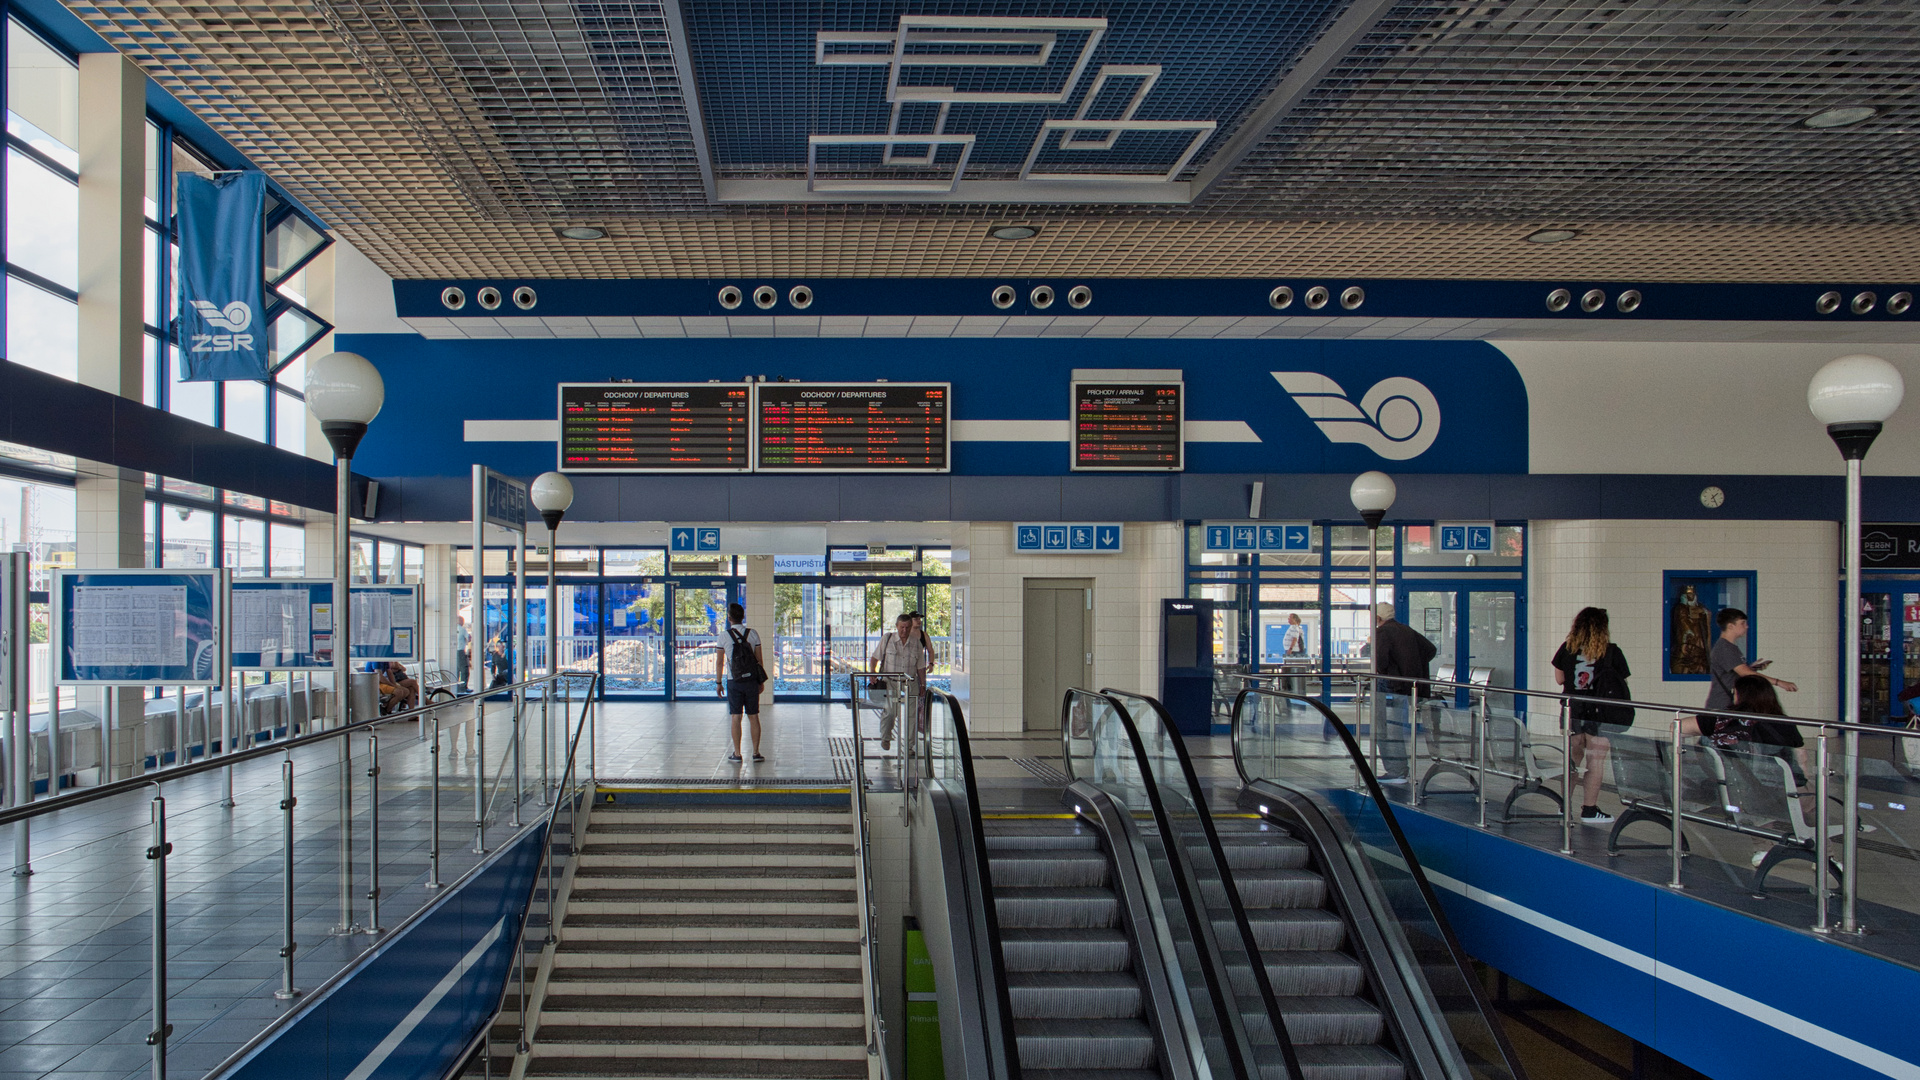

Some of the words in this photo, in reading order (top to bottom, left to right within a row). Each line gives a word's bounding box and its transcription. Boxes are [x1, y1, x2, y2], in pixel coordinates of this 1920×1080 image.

[604, 391, 639, 399] ODCHODY
[644, 391, 689, 399] DEPARTURES
[841, 391, 887, 399] DEPARTURES
